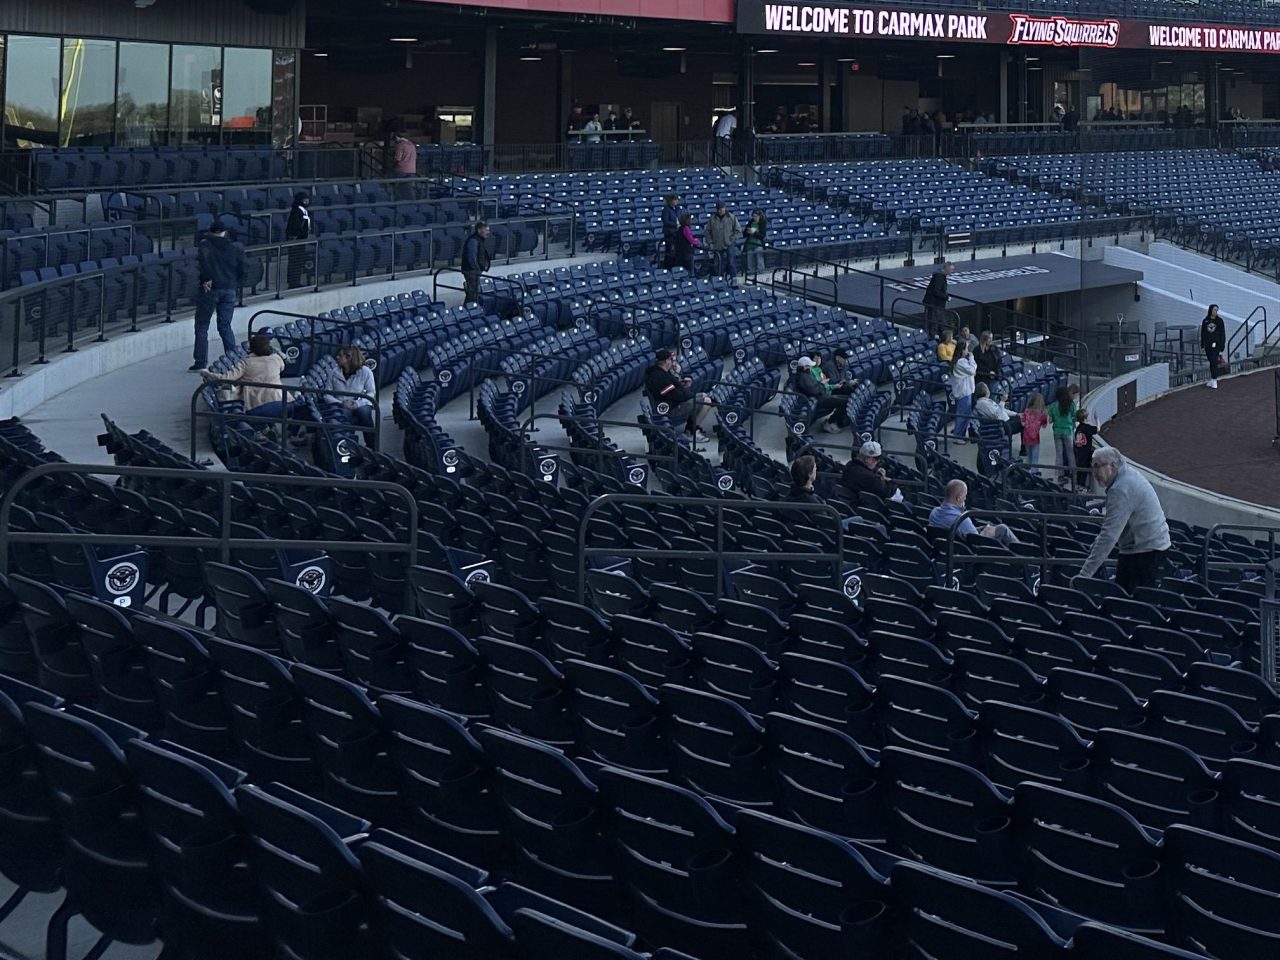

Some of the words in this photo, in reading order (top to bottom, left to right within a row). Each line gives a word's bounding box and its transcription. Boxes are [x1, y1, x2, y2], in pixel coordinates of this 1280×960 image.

[765, 4, 849, 33] WELCOME
[852, 9, 874, 34] TO
[878, 11, 945, 38] CARMAX
[948, 15, 987, 39] PARK
[1149, 25, 1202, 47] WELCOME
[1203, 28, 1217, 48] TO
[1219, 29, 1262, 50] CARMAX
